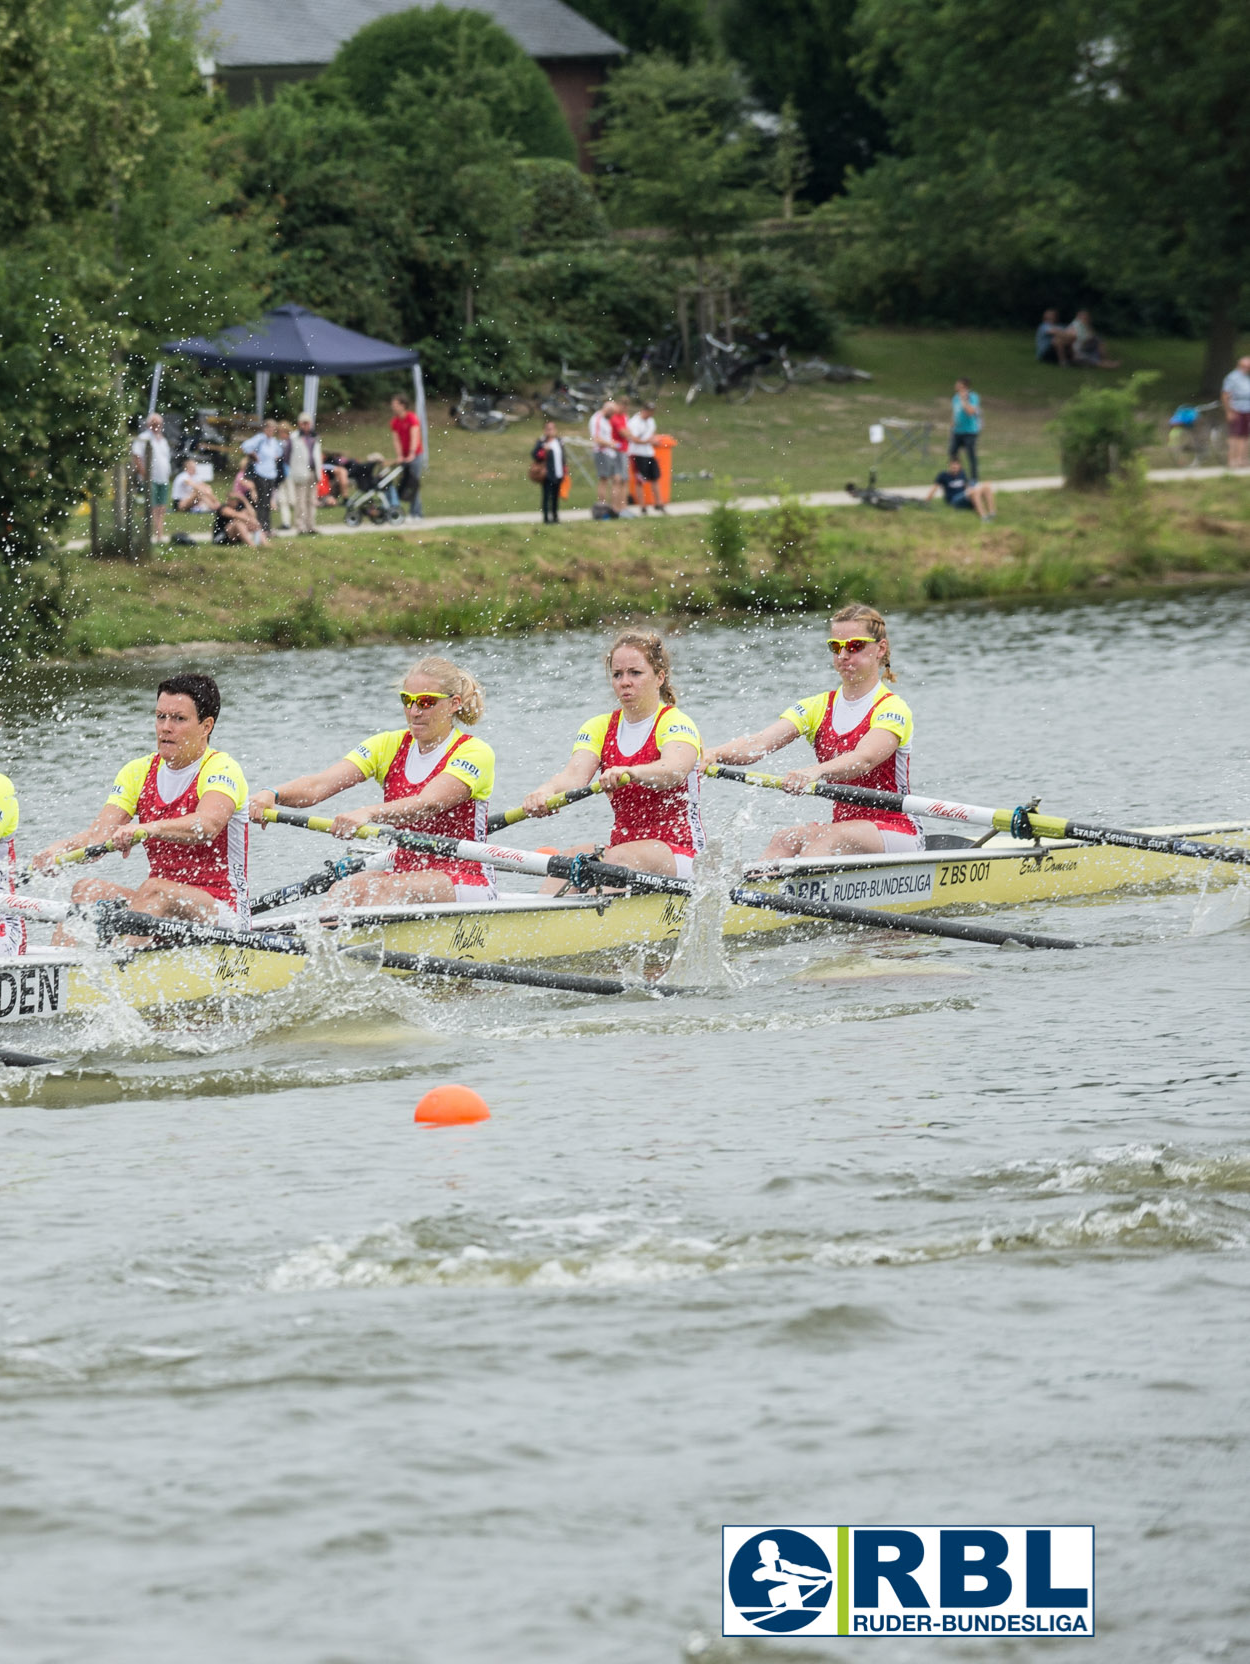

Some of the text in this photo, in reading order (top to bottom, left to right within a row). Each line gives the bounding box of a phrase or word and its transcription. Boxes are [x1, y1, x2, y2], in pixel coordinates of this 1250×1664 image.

[886, 713, 905, 726] RBL
[460, 760, 479, 779] RBL
[926, 801, 969, 822] Melitta
[479, 846, 525, 863] Melitta
[938, 861, 991, 886] Z BS 001
[832, 873, 931, 903] RUDER-BUNDESLIGA
[447, 917, 486, 951] Melitta
